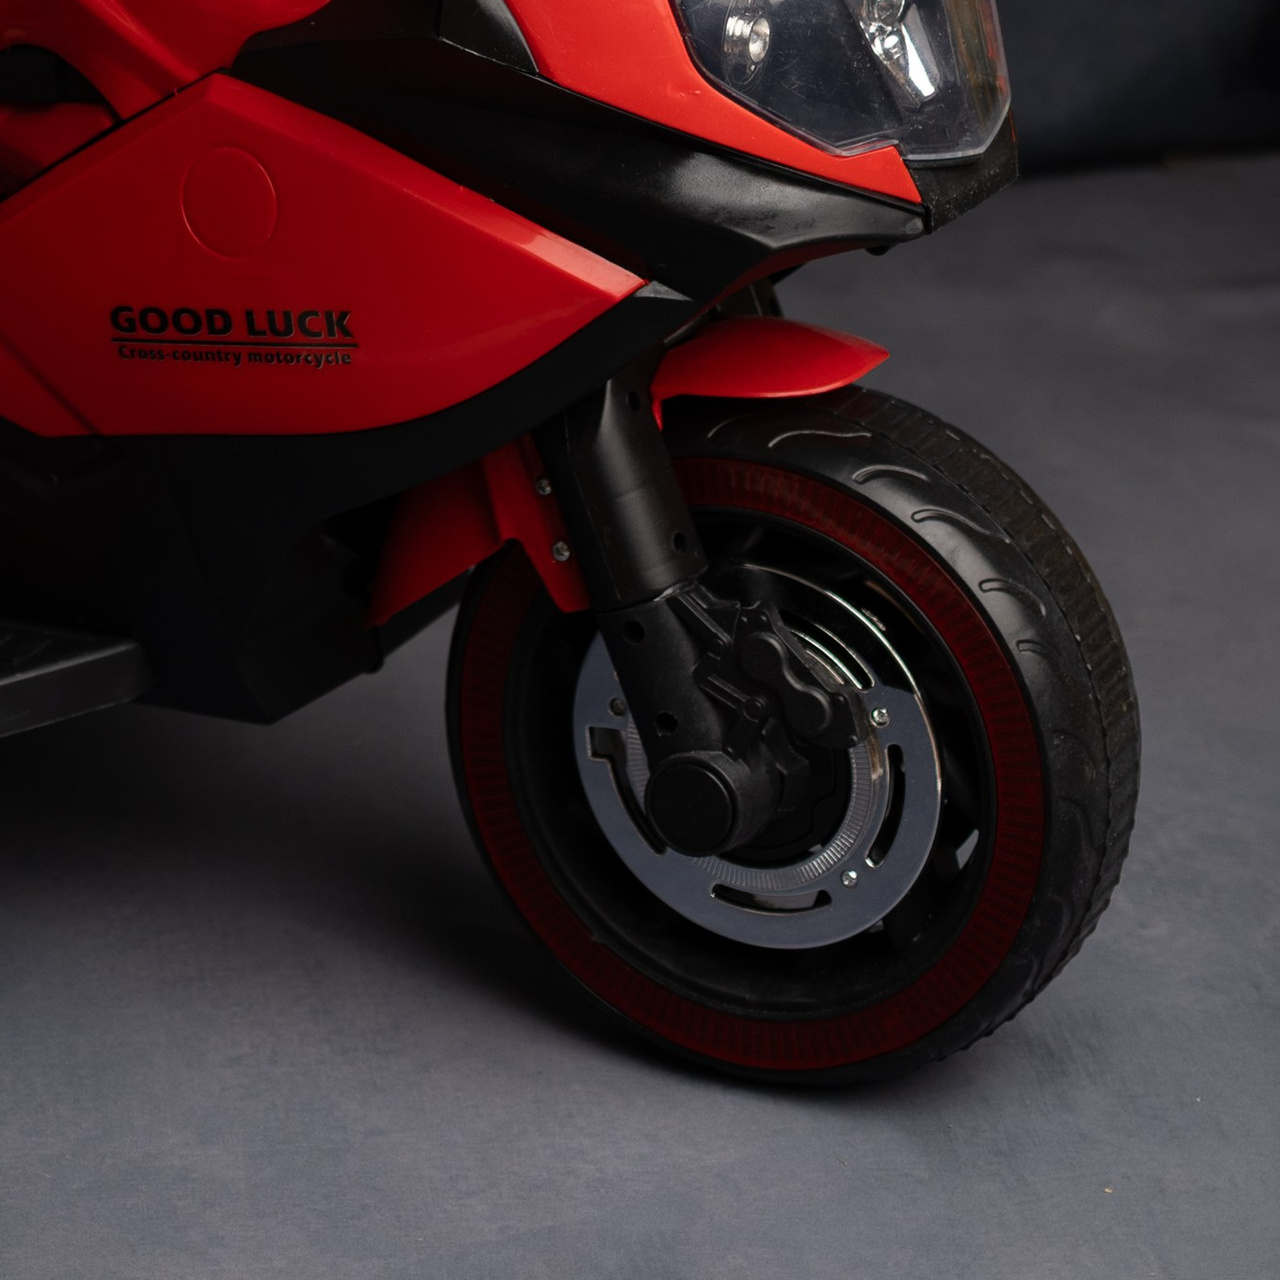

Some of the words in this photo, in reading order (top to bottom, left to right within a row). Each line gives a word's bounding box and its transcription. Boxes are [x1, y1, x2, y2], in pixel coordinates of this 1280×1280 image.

[110, 306, 233, 336] GOOD
[244, 309, 355, 339] LUCK
[117, 345, 242, 367] Cross-country
[247, 351, 352, 369] motorcycle
